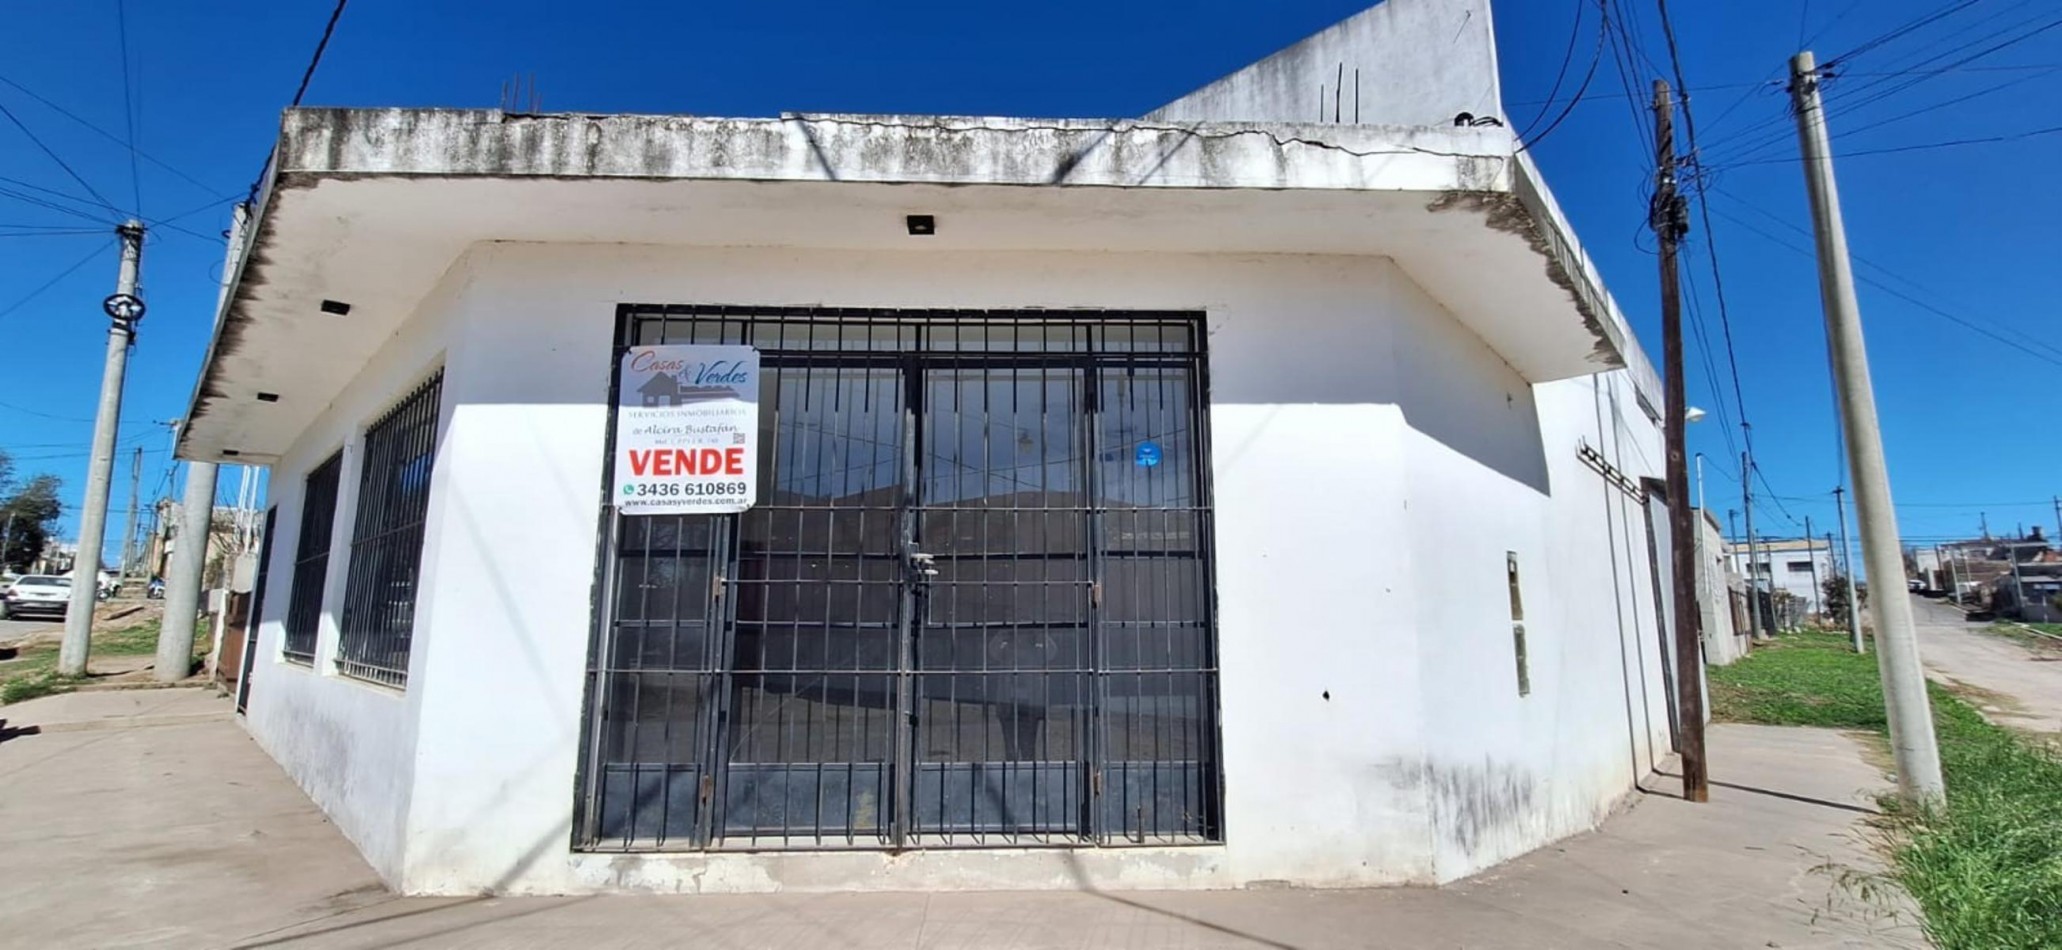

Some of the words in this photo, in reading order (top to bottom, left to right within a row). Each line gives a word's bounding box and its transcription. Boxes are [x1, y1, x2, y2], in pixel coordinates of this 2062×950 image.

[631, 350, 684, 373] Casas
[678, 364, 692, 383] &
[695, 360, 747, 385] Verdes
[629, 409, 675, 421] SERVICIOS
[677, 407, 747, 419] INMOBILIARIOS
[644, 424, 682, 435] Alcira
[629, 448, 744, 476] VENDE
[637, 483, 680, 496] 3436
[685, 481, 747, 496] 610869
[624, 497, 748, 507] www.casasyverdes.com.ar
